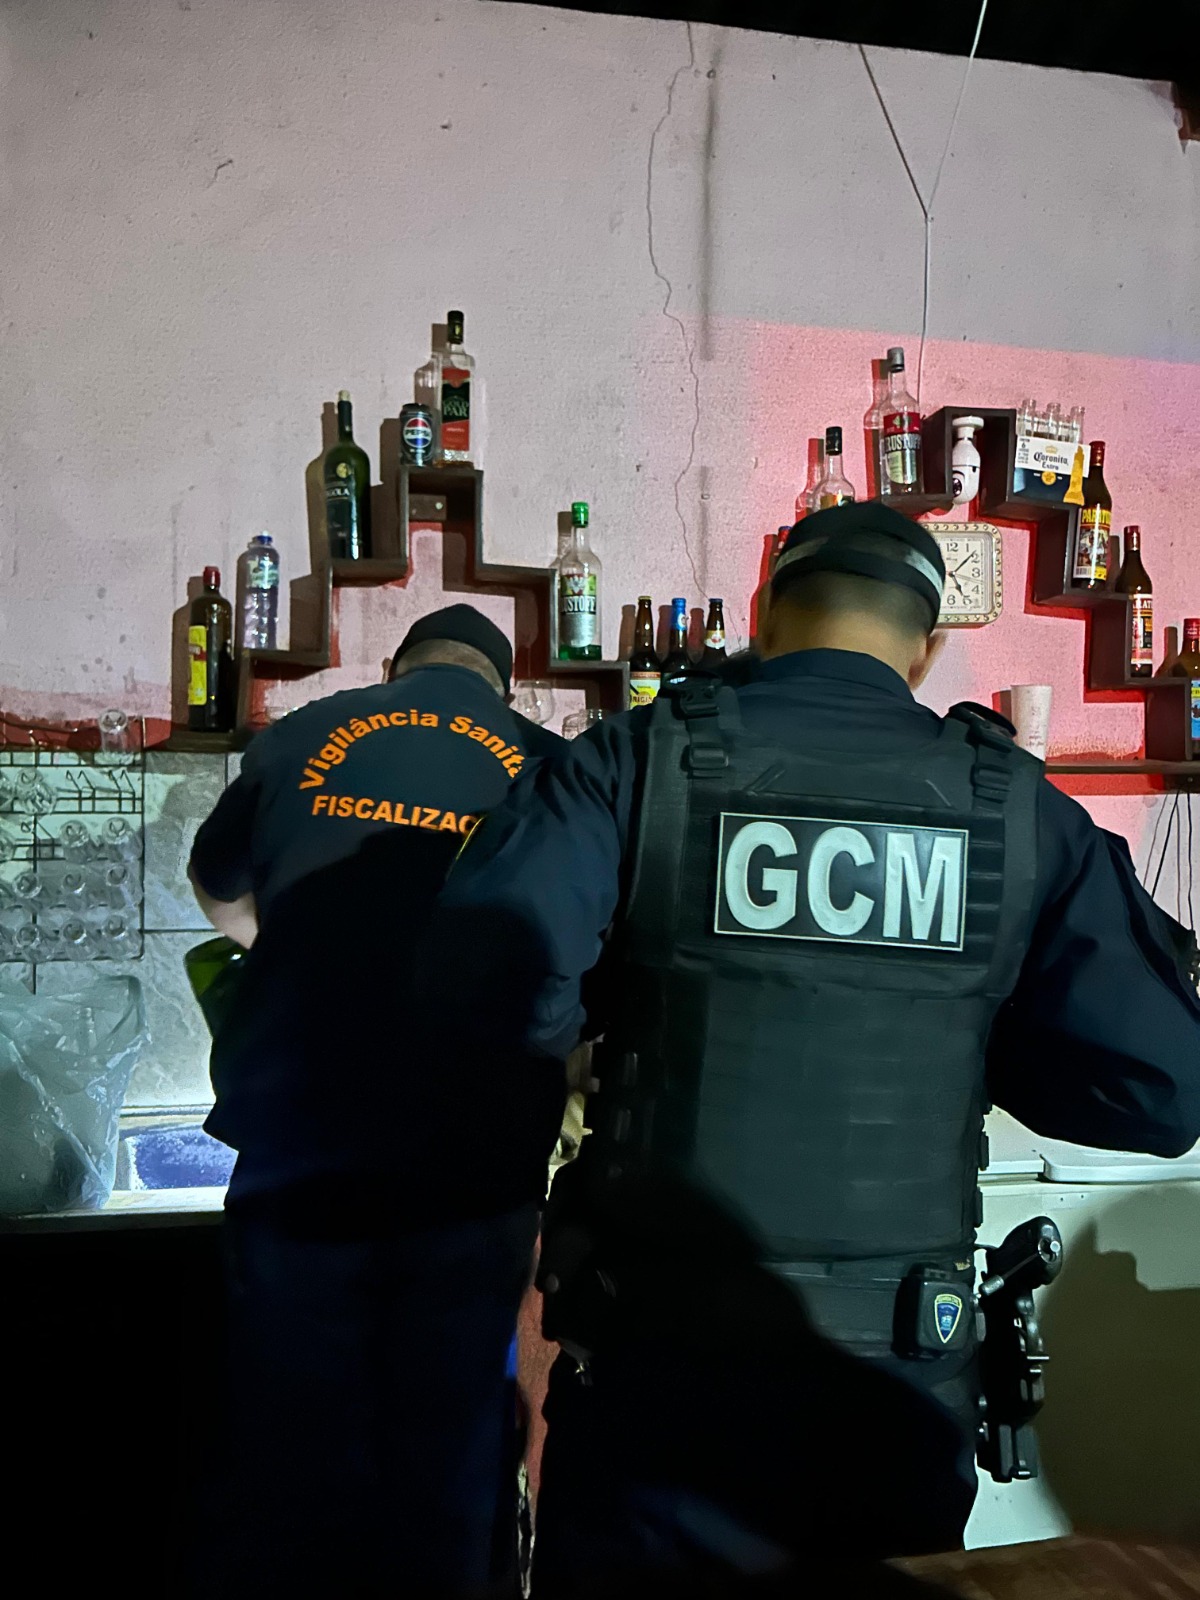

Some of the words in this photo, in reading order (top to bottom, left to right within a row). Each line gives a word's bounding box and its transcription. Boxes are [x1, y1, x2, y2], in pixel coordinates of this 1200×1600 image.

[1033, 452, 1069, 466] Coronita
[946, 542, 958, 553] 12
[965, 543, 970, 552] 1
[970, 553, 980, 564] 2
[971, 567, 980, 578] 3
[971, 585, 980, 595] 4
[946, 594, 956, 606] 6
[962, 595, 972, 606] 5
[299, 709, 439, 790] Vigilância
[725, 821, 962, 943] GCM
